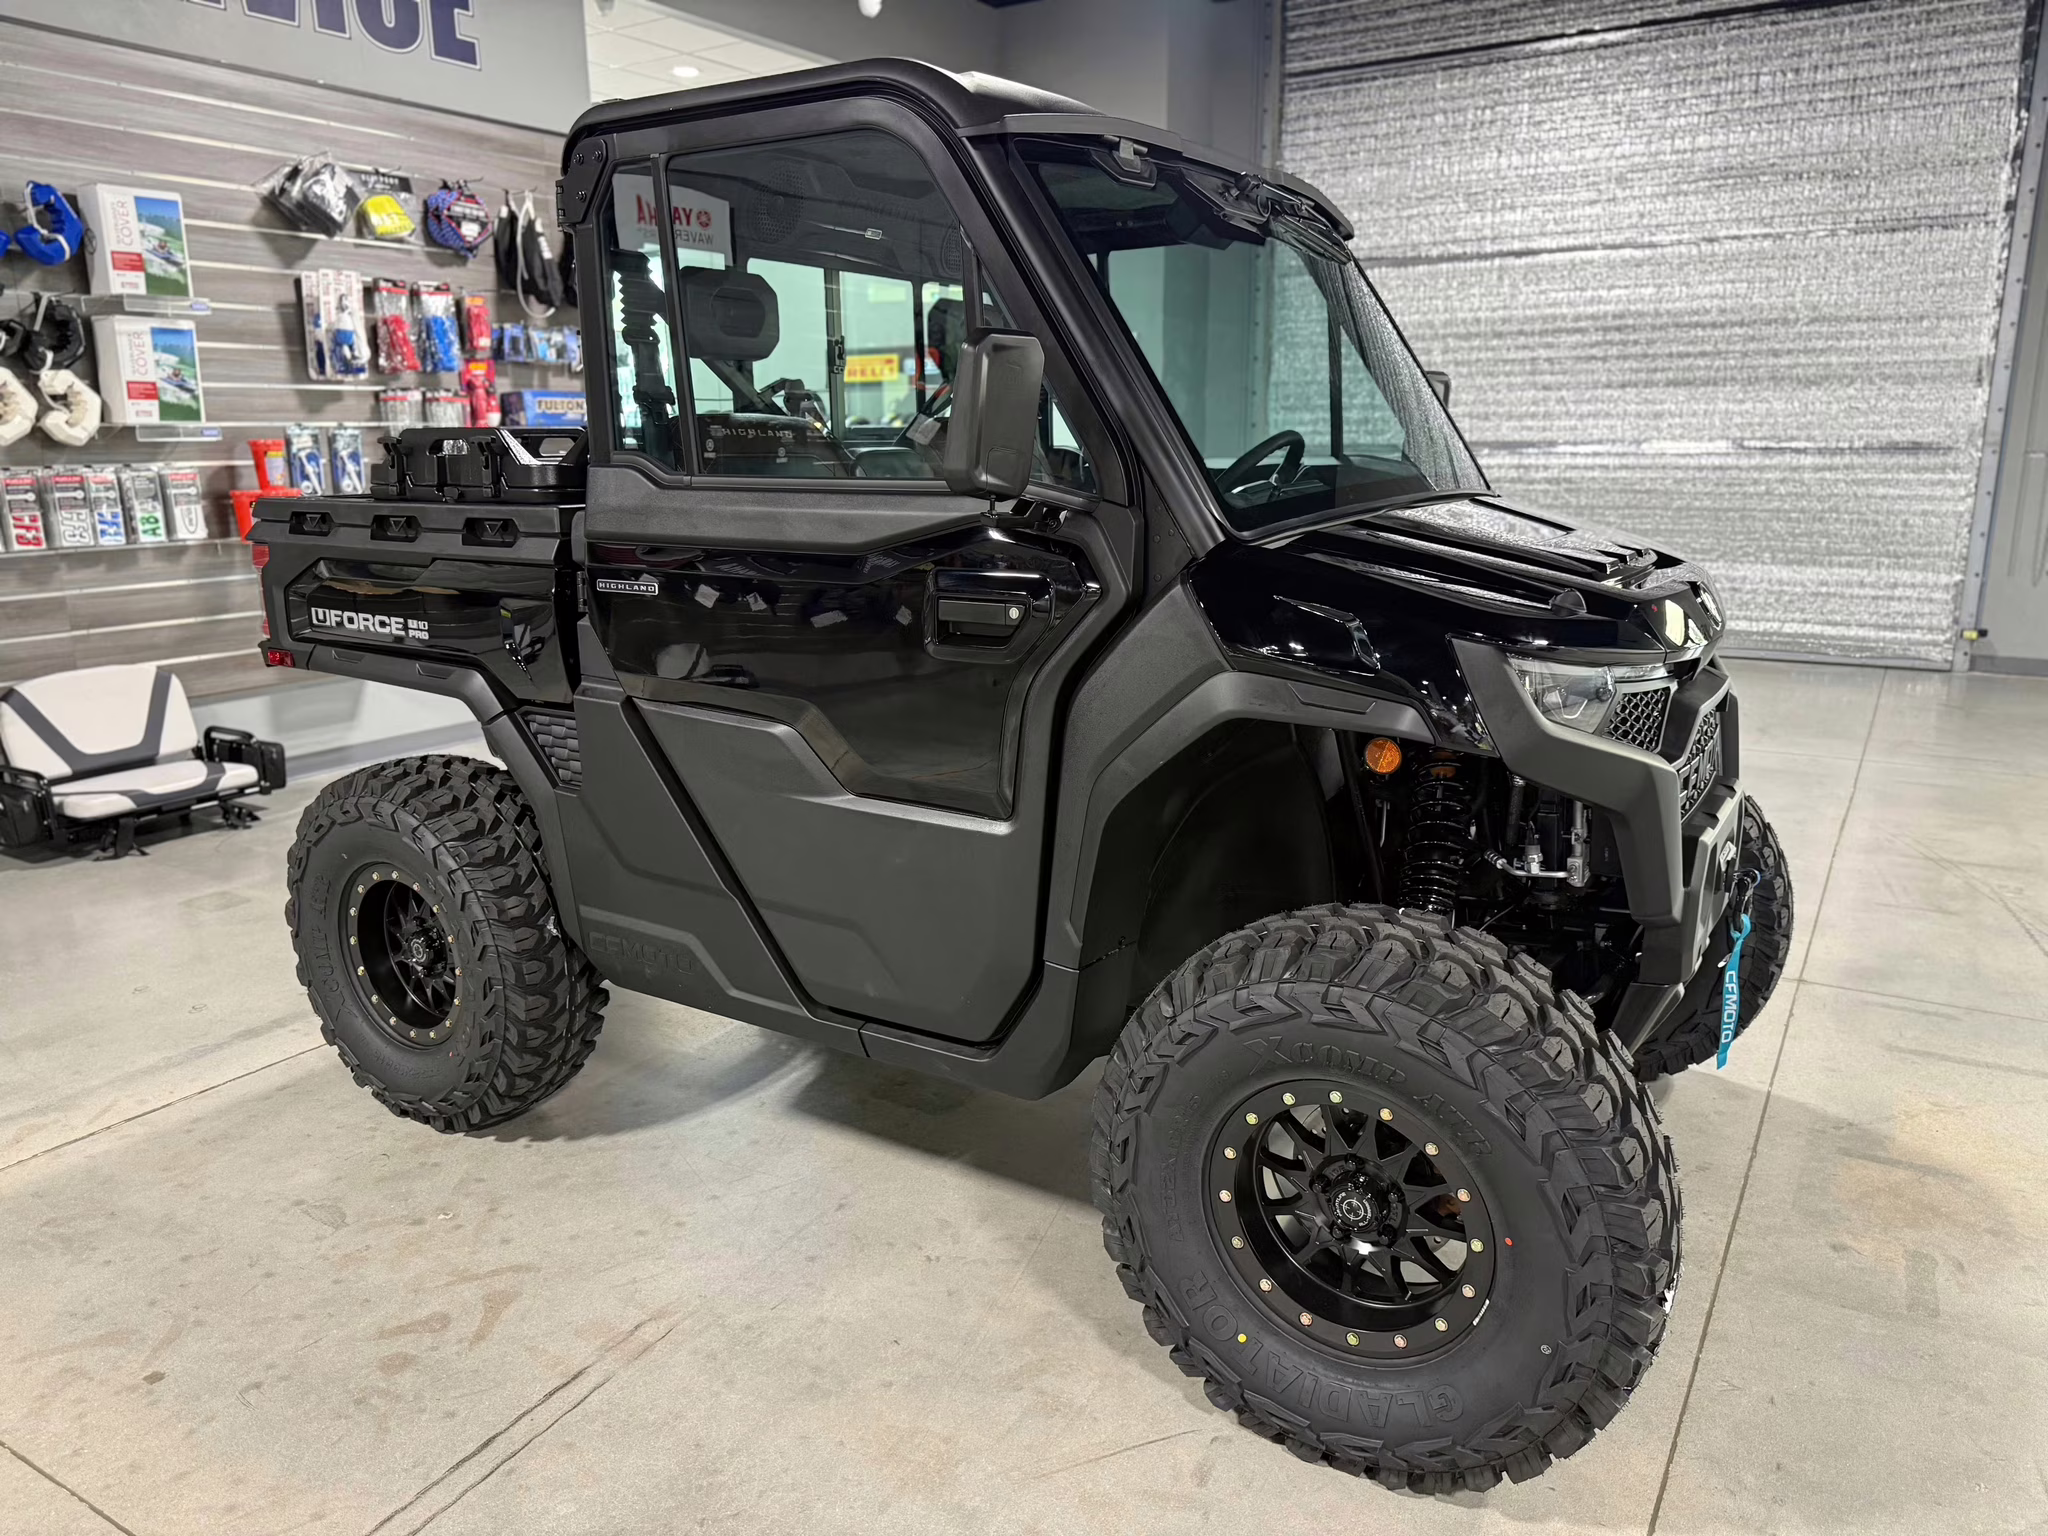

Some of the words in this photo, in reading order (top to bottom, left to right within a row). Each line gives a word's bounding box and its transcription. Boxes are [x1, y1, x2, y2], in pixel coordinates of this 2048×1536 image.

[117, 199, 133, 247] COVER
[132, 331, 149, 377] COVER
[537, 399, 584, 411] FULTON
[722, 428, 793, 439] HIGHLAND
[599, 582, 655, 592] HIGHLAND
[407, 618, 428, 630] U10
[408, 629, 429, 640] PRO
[588, 931, 695, 977] CFMOTO
[1721, 970, 1737, 1043] CFMOTO
[1178, 1270, 1464, 1429] GLADIATOR
